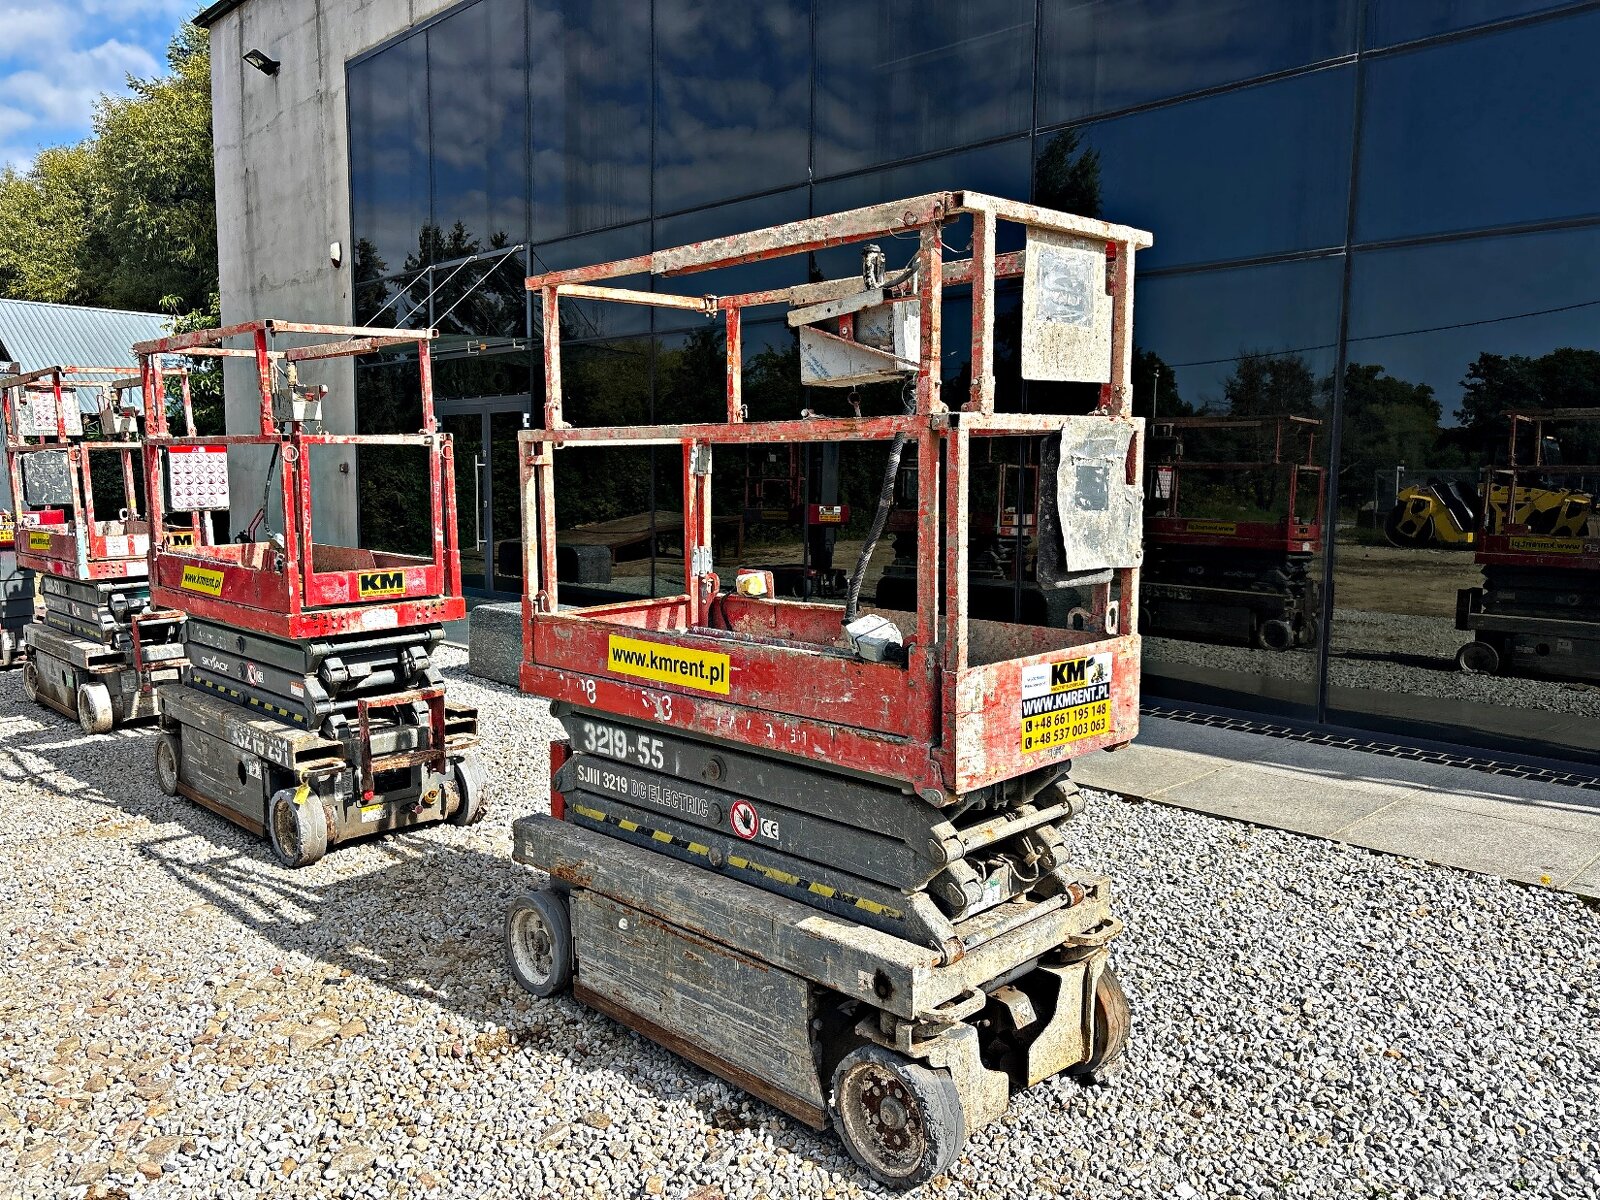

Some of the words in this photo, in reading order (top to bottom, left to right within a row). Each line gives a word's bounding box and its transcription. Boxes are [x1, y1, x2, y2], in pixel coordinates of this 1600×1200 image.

[361, 573, 404, 591] KM
[201, 656, 230, 672] SKYJACK
[612, 647, 725, 685] www.kmrent.pl
[1051, 660, 1086, 687] KM
[1022, 684, 1109, 716] WWW.KMRENT.PL
[1034, 716, 1052, 730] +48
[1054, 711, 1070, 725] 661
[1073, 707, 1089, 720] 195
[1092, 703, 1107, 716] 148
[1033, 731, 1051, 746] +48
[1053, 727, 1070, 742] 537
[1072, 722, 1088, 737] 003
[1090, 718, 1106, 732] 063
[577, 764, 600, 786] SJIII
[602, 771, 628, 794] 3219
[630, 778, 647, 799] DC
[648, 784, 709, 818] ELECTRIC
[762, 820, 779, 837] CE
